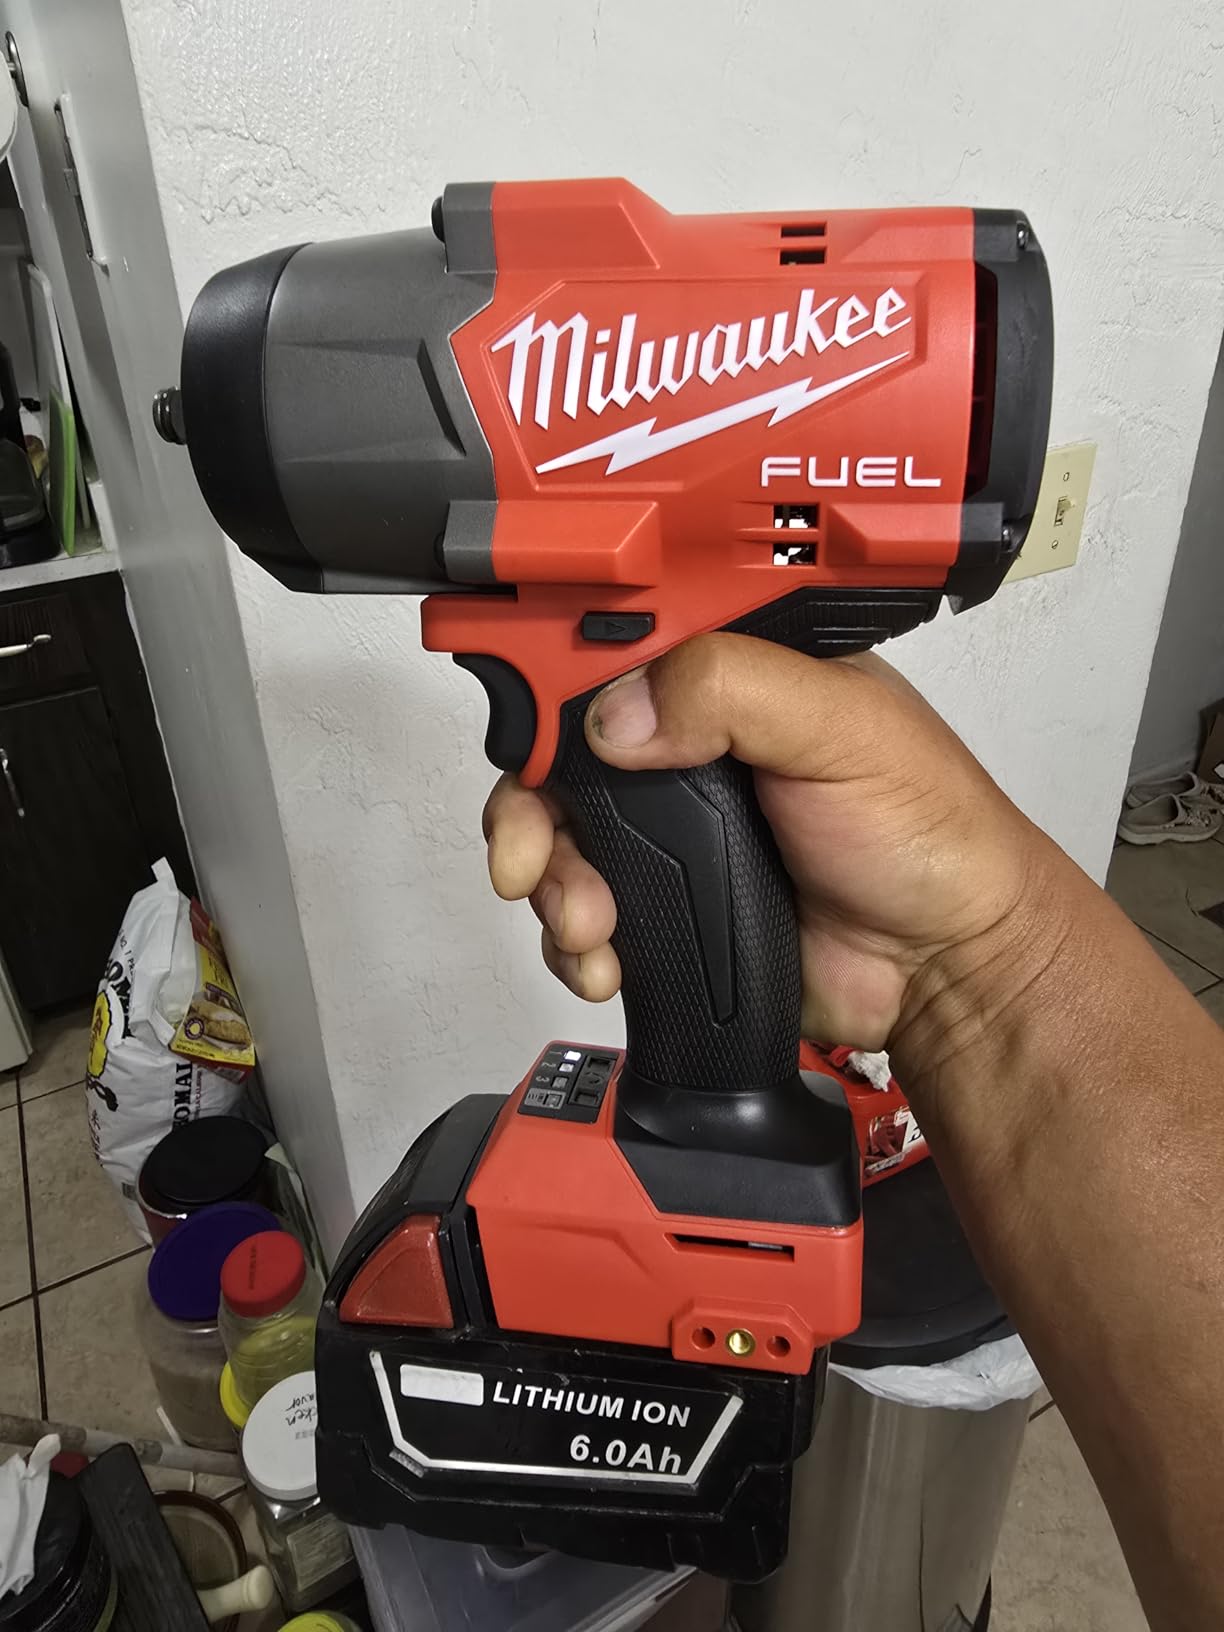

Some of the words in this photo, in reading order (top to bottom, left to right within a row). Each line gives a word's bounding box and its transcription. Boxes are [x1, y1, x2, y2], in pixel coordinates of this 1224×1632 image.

[491, 287, 912, 430] Milwaukee
[760, 456, 941, 487] FUEL
[535, 1075, 550, 1083] 3
[493, 1382, 625, 1419] LITHIUM
[631, 1399, 691, 1427] ION
[570, 1434, 682, 1474] 6.0Ah
